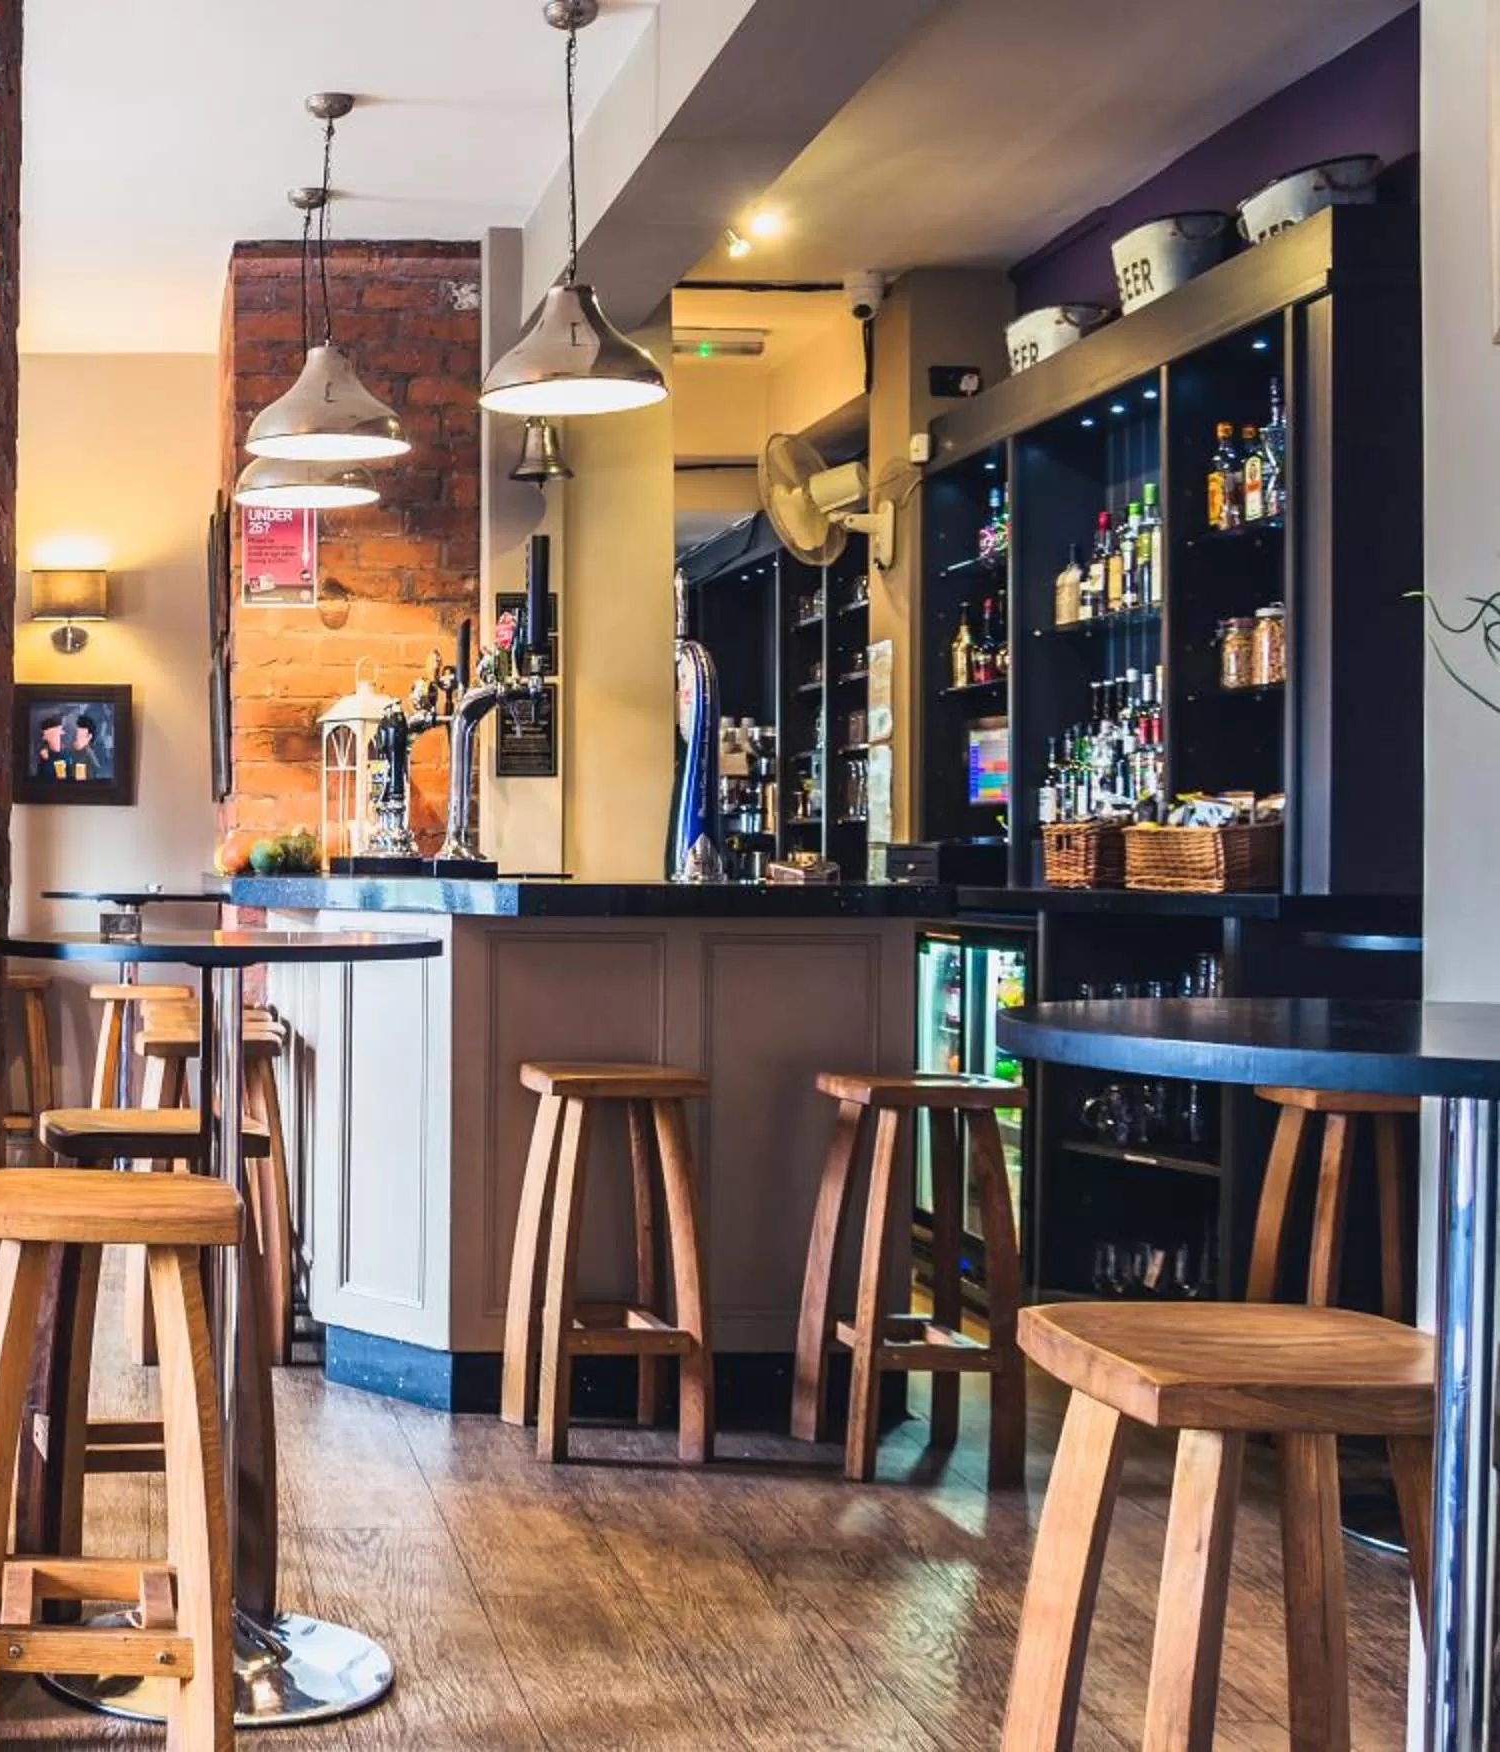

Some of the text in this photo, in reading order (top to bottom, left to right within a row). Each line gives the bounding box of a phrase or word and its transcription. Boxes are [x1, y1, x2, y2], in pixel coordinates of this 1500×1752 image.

[1116, 258, 1155, 304] EER
[1008, 341, 1039, 373] EER
[248, 509, 293, 521] UNDER
